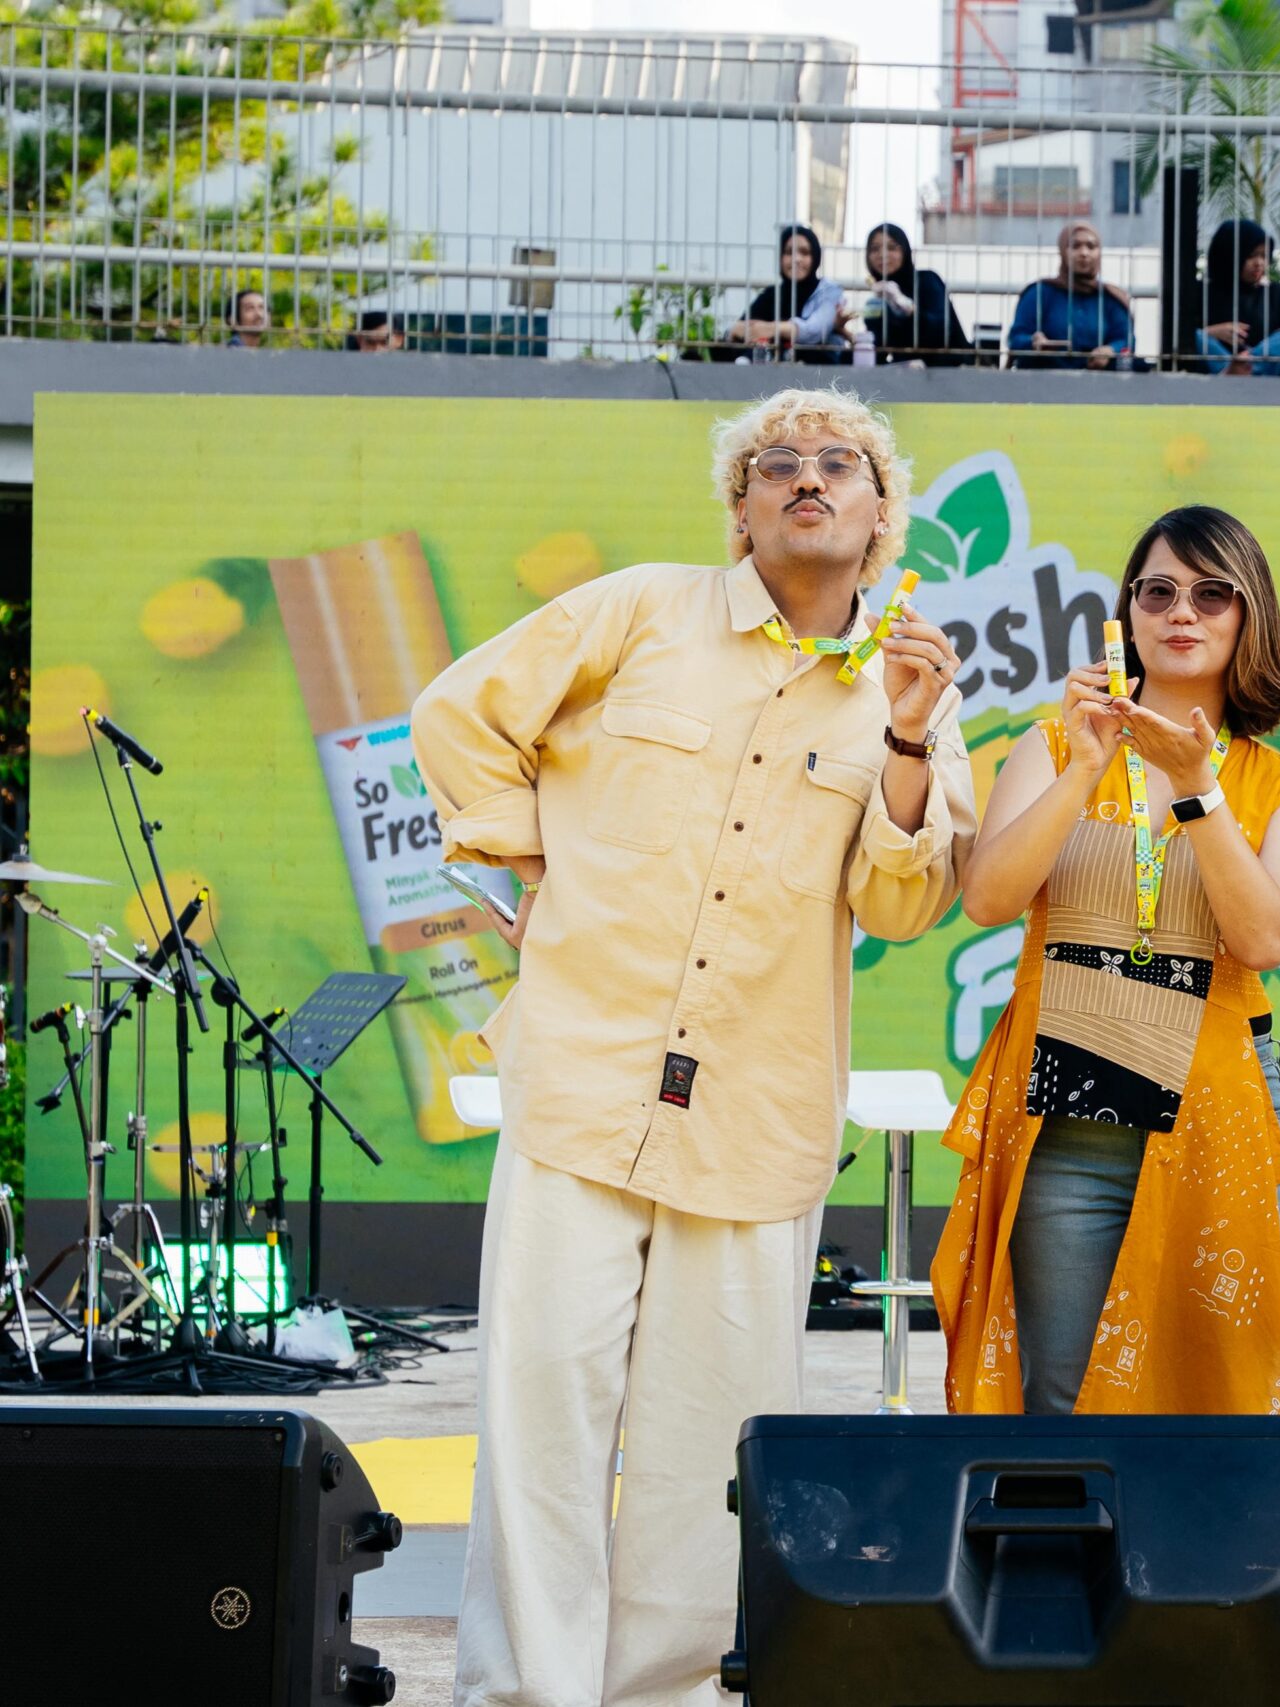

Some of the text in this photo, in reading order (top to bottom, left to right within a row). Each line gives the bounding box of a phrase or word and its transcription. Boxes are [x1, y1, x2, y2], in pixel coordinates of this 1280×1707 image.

[938, 563, 1109, 699] esh
[354, 777, 389, 809] So
[362, 811, 442, 862] Fres
[420, 918, 466, 938] Citrus
[429, 958, 478, 979] Roll On
